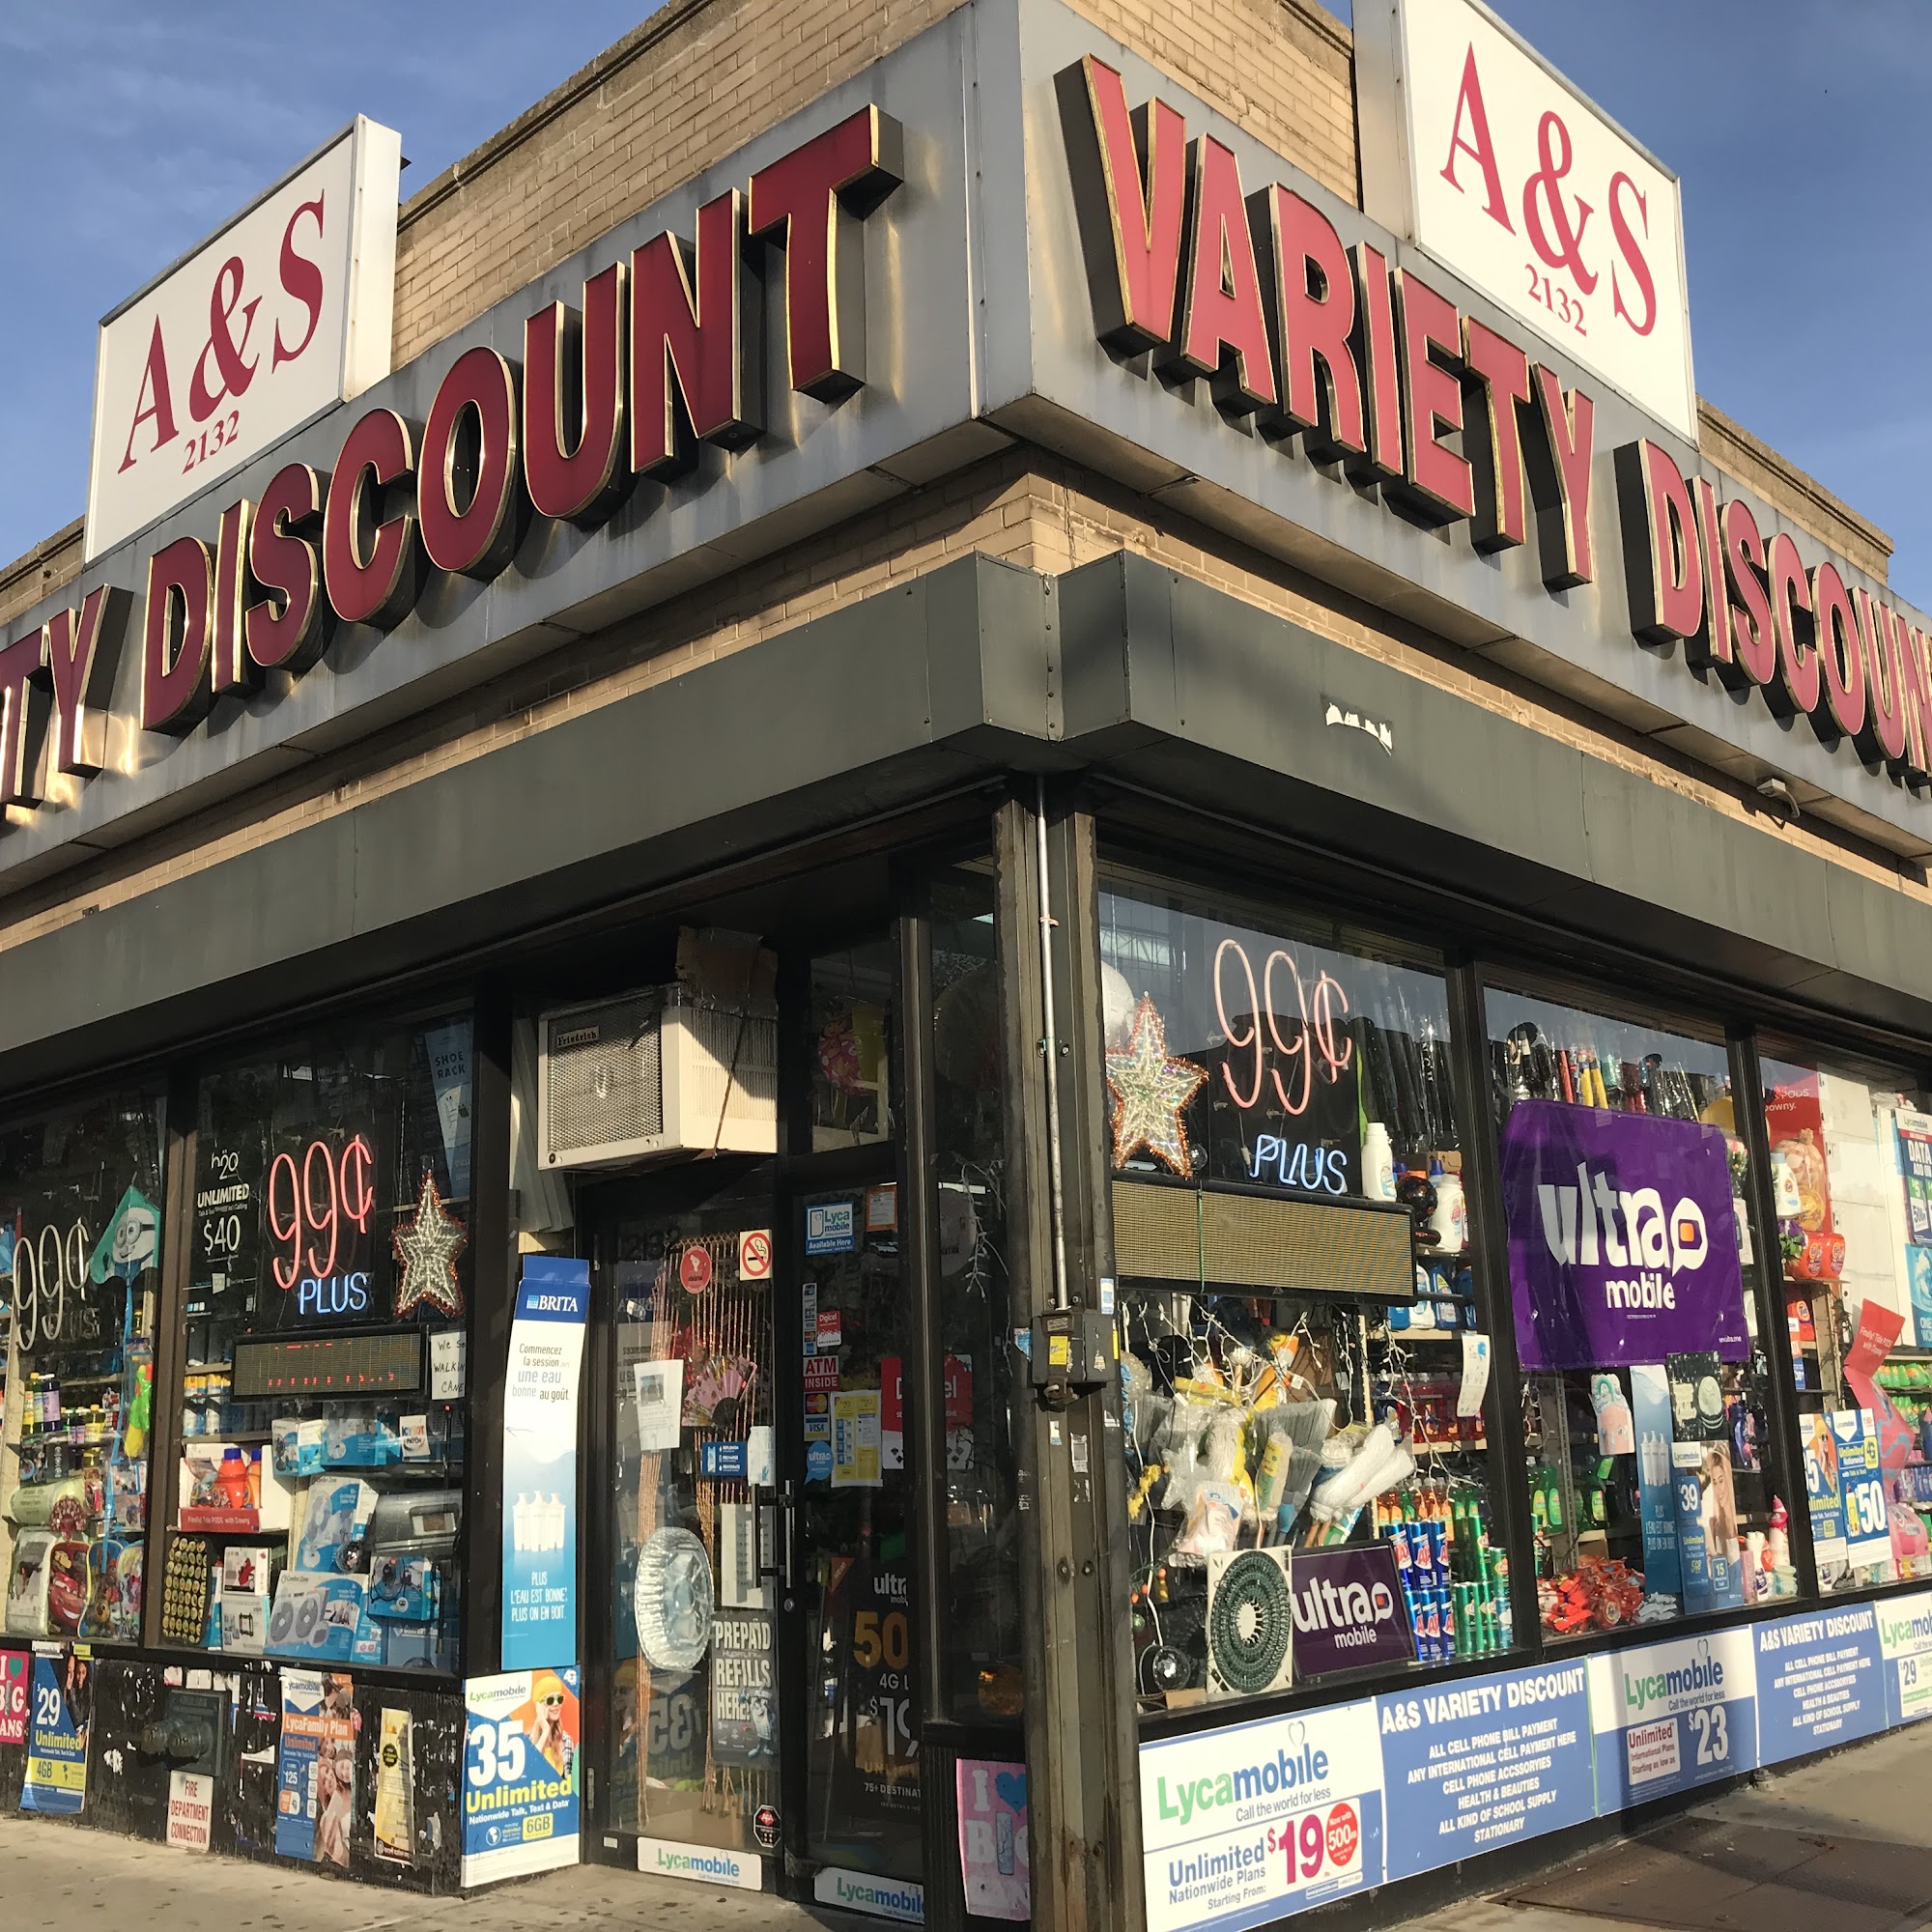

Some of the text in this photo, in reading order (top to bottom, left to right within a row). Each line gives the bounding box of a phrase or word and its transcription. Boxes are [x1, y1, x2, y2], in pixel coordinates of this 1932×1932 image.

[1439, 41, 1658, 337] A&S
[1525, 264, 1587, 337] 2132
[118, 189, 326, 474] A&S
[141, 102, 889, 732] DISCOUNT
[1063, 53, 1932, 776] VARIETY DISCOUN
[182, 409, 240, 474] 2132
[557, 1030, 597, 1046] Friedrich
[1213, 938, 1352, 1116] 99¢
[435, 1051, 464, 1067] SHOE
[438, 1065, 466, 1080] RACK
[1908, 1140, 1932, 1164] DATA
[1250, 1133, 1349, 1195] PLUS
[197, 1183, 249, 1208] UNLIMITED
[269, 1134, 373, 1290] 99¢
[824, 1208, 850, 1224] Lyca
[1538, 1161, 1672, 1270] ultra
[204, 1214, 241, 1256] $40
[825, 1222, 850, 1233] mobile
[809, 1238, 851, 1250] Available Here
[298, 1272, 367, 1315] PLUS
[1605, 1272, 1676, 1310] mobile
[538, 1294, 579, 1312] BRITA
[819, 1313, 838, 1322] Digicel
[438, 1341, 451, 1351] We
[519, 1343, 562, 1355] Commencez
[523, 1356, 559, 1367] la session
[805, 1358, 837, 1376] ATM
[441, 1381, 464, 1393] CANE
[518, 1370, 561, 1383] une eau
[805, 1377, 838, 1388] INSIDE
[512, 1384, 550, 1400] bonne au
[809, 1424, 824, 1433] VISA
[1674, 1451, 1700, 1463] Lycamobile
[1839, 1444, 1864, 1458] Unlimited
[1866, 1440, 1876, 1460] 4G
[1678, 1483, 1698, 1512] $39
[1856, 1480, 1886, 1534] $50
[1683, 1535, 1704, 1546] Unlimited
[531, 1571, 548, 1585] PLUS
[834, 1562, 847, 1579] NEW!
[1716, 1563, 1725, 1576] 15
[530, 1588, 543, 1604] EST
[1293, 1577, 1370, 1634] ultra
[511, 1605, 550, 1621] PLUS ON EN
[715, 1619, 771, 1650] PREPAID
[853, 1610, 908, 1670] 50
[1334, 1625, 1377, 1648] mobile
[1760, 1610, 1873, 1652] A&S VARIETY DISCOUNT
[716, 1658, 771, 1688] REFILLS
[1785, 1662, 1794, 1672] ALL
[1794, 1658, 1807, 1669] CELL
[469, 1685, 526, 1701] Lycamobile
[879, 1673, 898, 1690] 4G
[1624, 1656, 1723, 1711] Lycamobile
[1793, 1687, 1806, 1698] CELL
[1382, 1667, 1584, 1734] A&S VARIETY DISCOUNT
[1668, 1700, 1679, 1711] Call
[1680, 1697, 1689, 1709] the
[1690, 1694, 1704, 1707] world
[1714, 1690, 1725, 1701] less
[286, 1717, 348, 1736] LycaFamily Plan
[1689, 1705, 1728, 1766] $23
[35, 1729, 82, 1750] Unlimited
[1430, 1718, 1558, 1759] ALL CELL PHONE BILL PAYMENT
[1407, 1731, 1577, 1784] ANY INTERNATIONAL CELL PAYMENT HERE
[1631, 1743, 1675, 1761] International Plans
[37, 1760, 52, 1778] 4GB
[1443, 1755, 1551, 1795] CELL PHONE ACCSSORYIES
[1632, 1762, 1653, 1776] Starting
[1660, 1757, 1668, 1767] low
[185, 1780, 198, 1797] FIRE
[467, 1774, 572, 1813] Unlimited
[1157, 1743, 1329, 1826] Lycamobile
[1458, 1776, 1540, 1809] HEALTH & BEAUTIES
[171, 1804, 209, 1824] DEPARTMENT
[469, 1801, 551, 1825] Nationwide Talk, Text &
[1236, 1787, 1331, 1822] Call the world for less
[1439, 1789, 1557, 1835] ALL KIND OF SCHOOL SUPPLY
[526, 1815, 551, 1833] 6GB
[1329, 1810, 1352, 1827] Now with
[1474, 1816, 1525, 1843] STATIONARY
[171, 1824, 207, 1844] CONNECTION
[1267, 1813, 1324, 1886] $19
[658, 1847, 740, 1877] Lycamobile
[1169, 1837, 1264, 1888] Unlimited
[837, 1877, 924, 1914] Lycamobil
[1169, 1865, 1265, 1905] Nationwide Plans
[1208, 1885, 1266, 1910] Starting From:
